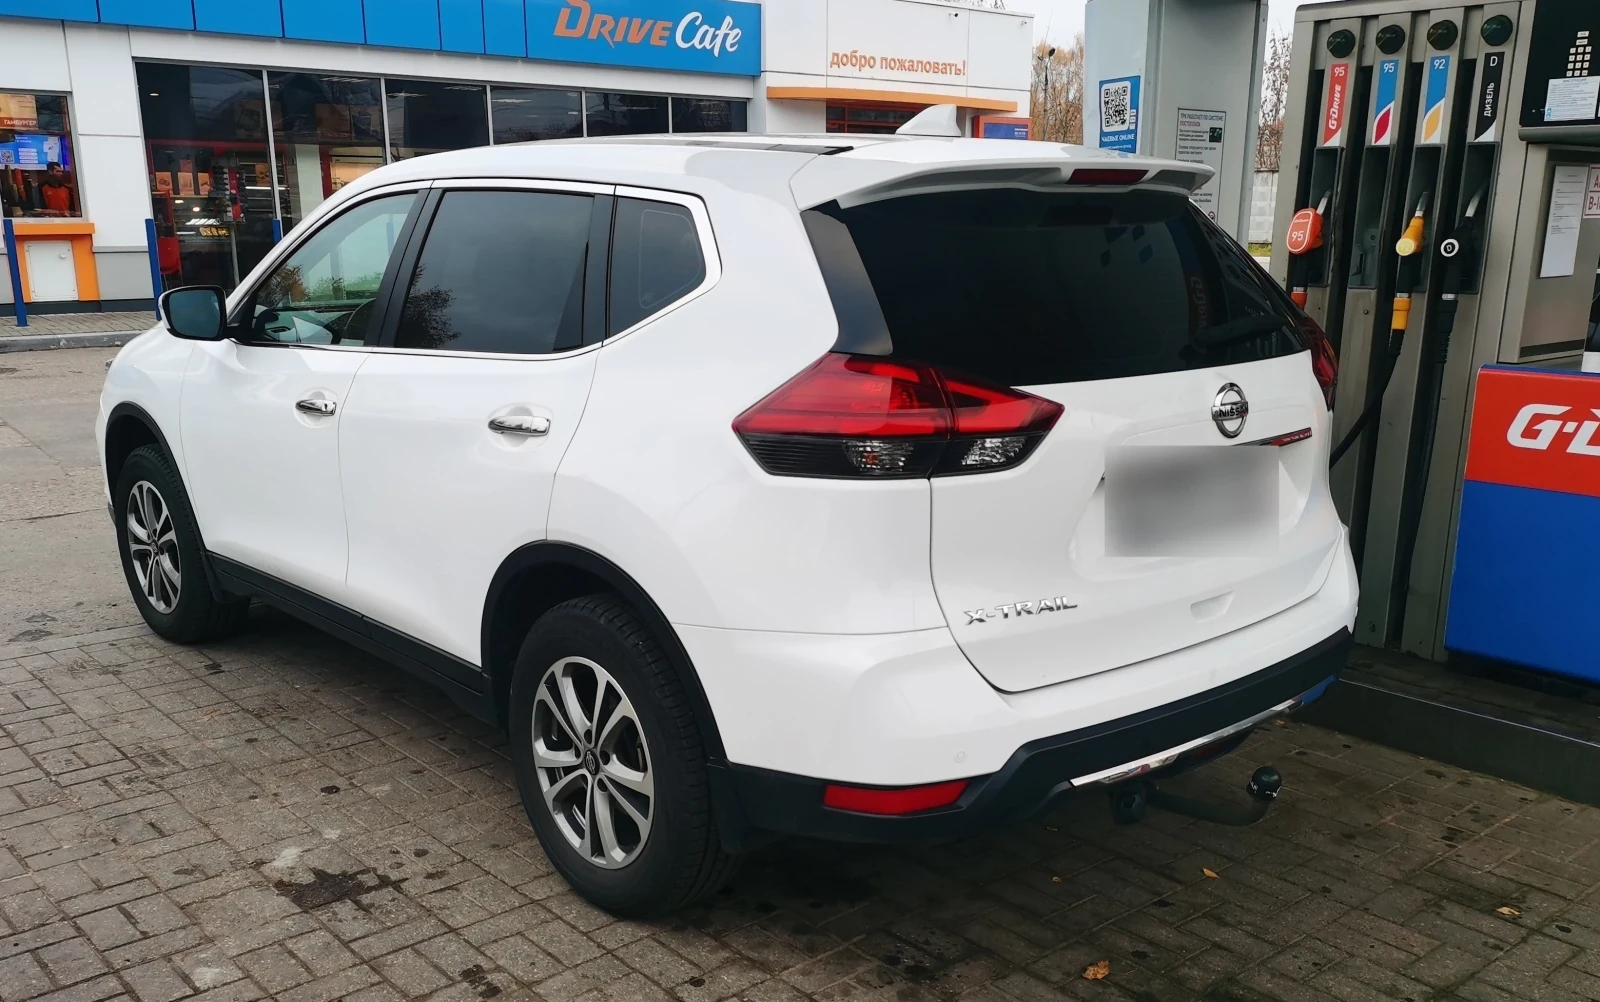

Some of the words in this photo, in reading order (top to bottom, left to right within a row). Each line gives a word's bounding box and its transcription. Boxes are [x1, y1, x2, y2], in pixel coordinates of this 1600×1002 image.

[554, 0, 673, 48] DRIVE
[676, 12, 742, 57] Cafe
[830, 50, 876, 71] добро
[880, 57, 966, 76] пожаловать!
[1434, 59, 1446, 70] 92
[1490, 56, 1499, 67] D
[1334, 67, 1345, 77] 95
[1384, 63, 1395, 73] 95
[1484, 82, 1495, 117] ДИЗЕЛЬ
[1292, 231, 1305, 242] 95
[963, 596, 1078, 626] X-TRAIL
